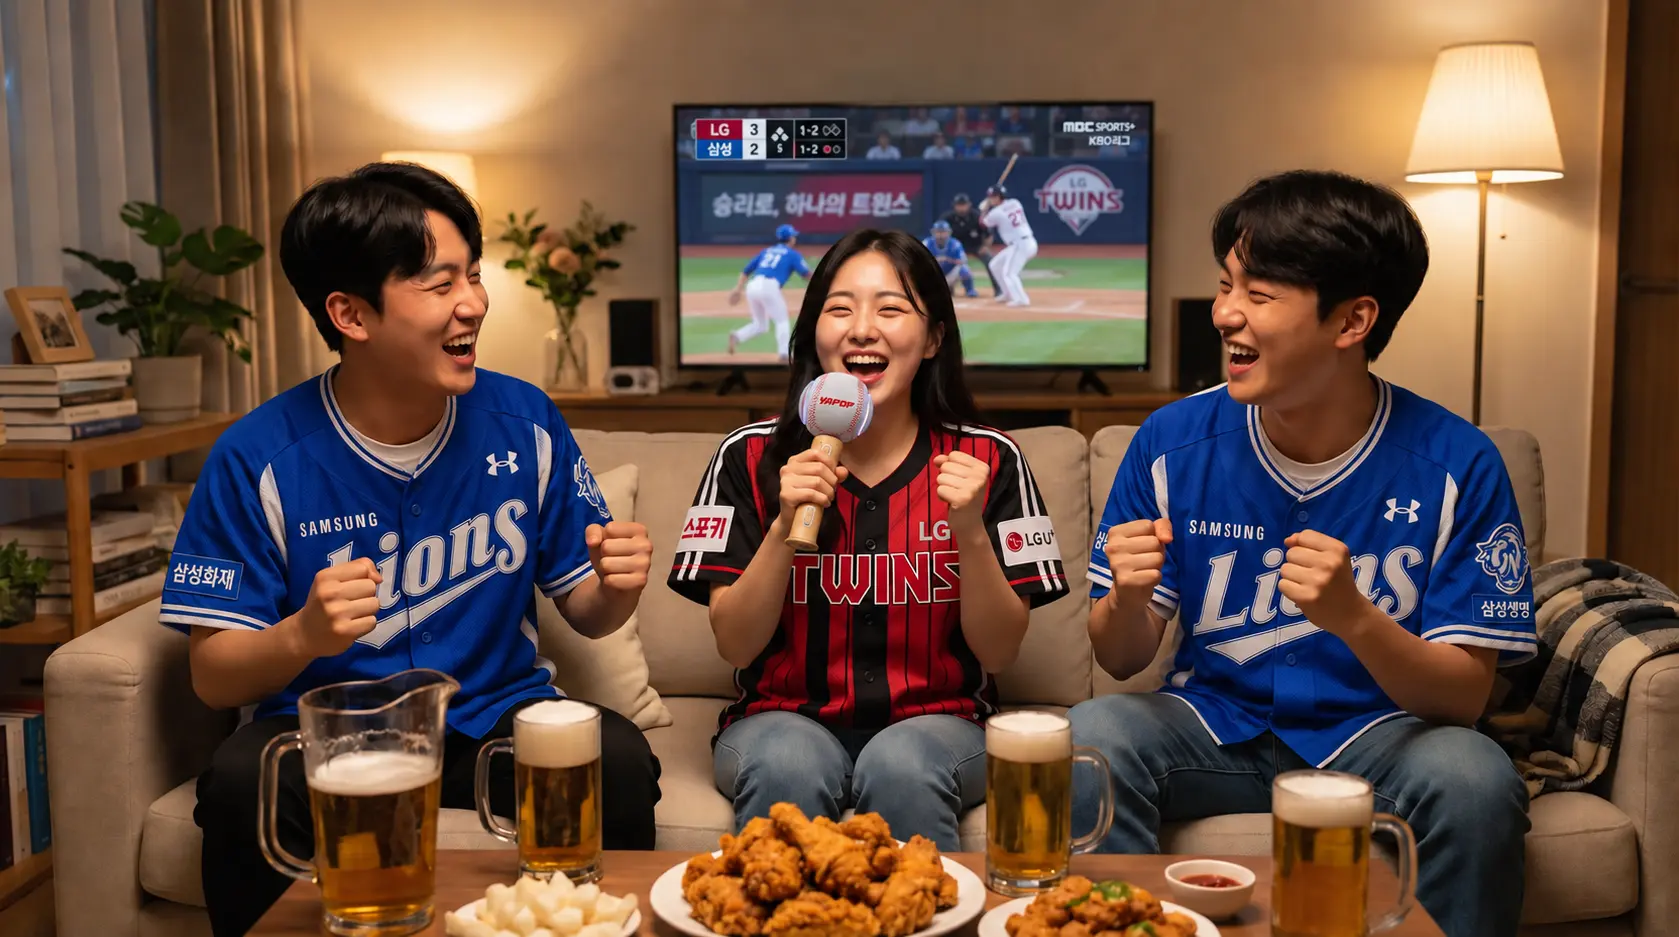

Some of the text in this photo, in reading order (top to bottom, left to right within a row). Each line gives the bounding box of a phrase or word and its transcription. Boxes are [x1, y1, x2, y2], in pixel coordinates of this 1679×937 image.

[710, 123, 758, 136] LG 3
[800, 125, 819, 136] 1-2
[1063, 121, 1094, 132] MBC
[707, 142, 758, 157] 삼성 2
[800, 145, 818, 154] 1-2
[1070, 177, 1087, 187] LG
[785, 192, 846, 217] 하나의
[1035, 190, 1123, 213] TWINS
[300, 512, 378, 538] SAMSUNG
[681, 517, 727, 540] 스포키
[919, 520, 950, 541] LG
[1189, 520, 1264, 541] SAMSUNG
[1025, 529, 1055, 547] LGU+
[327, 499, 528, 610] ions
[173, 562, 235, 591] 삼성화재
[792, 551, 961, 605] TWINS
[1193, 545, 1424, 636] Lins
